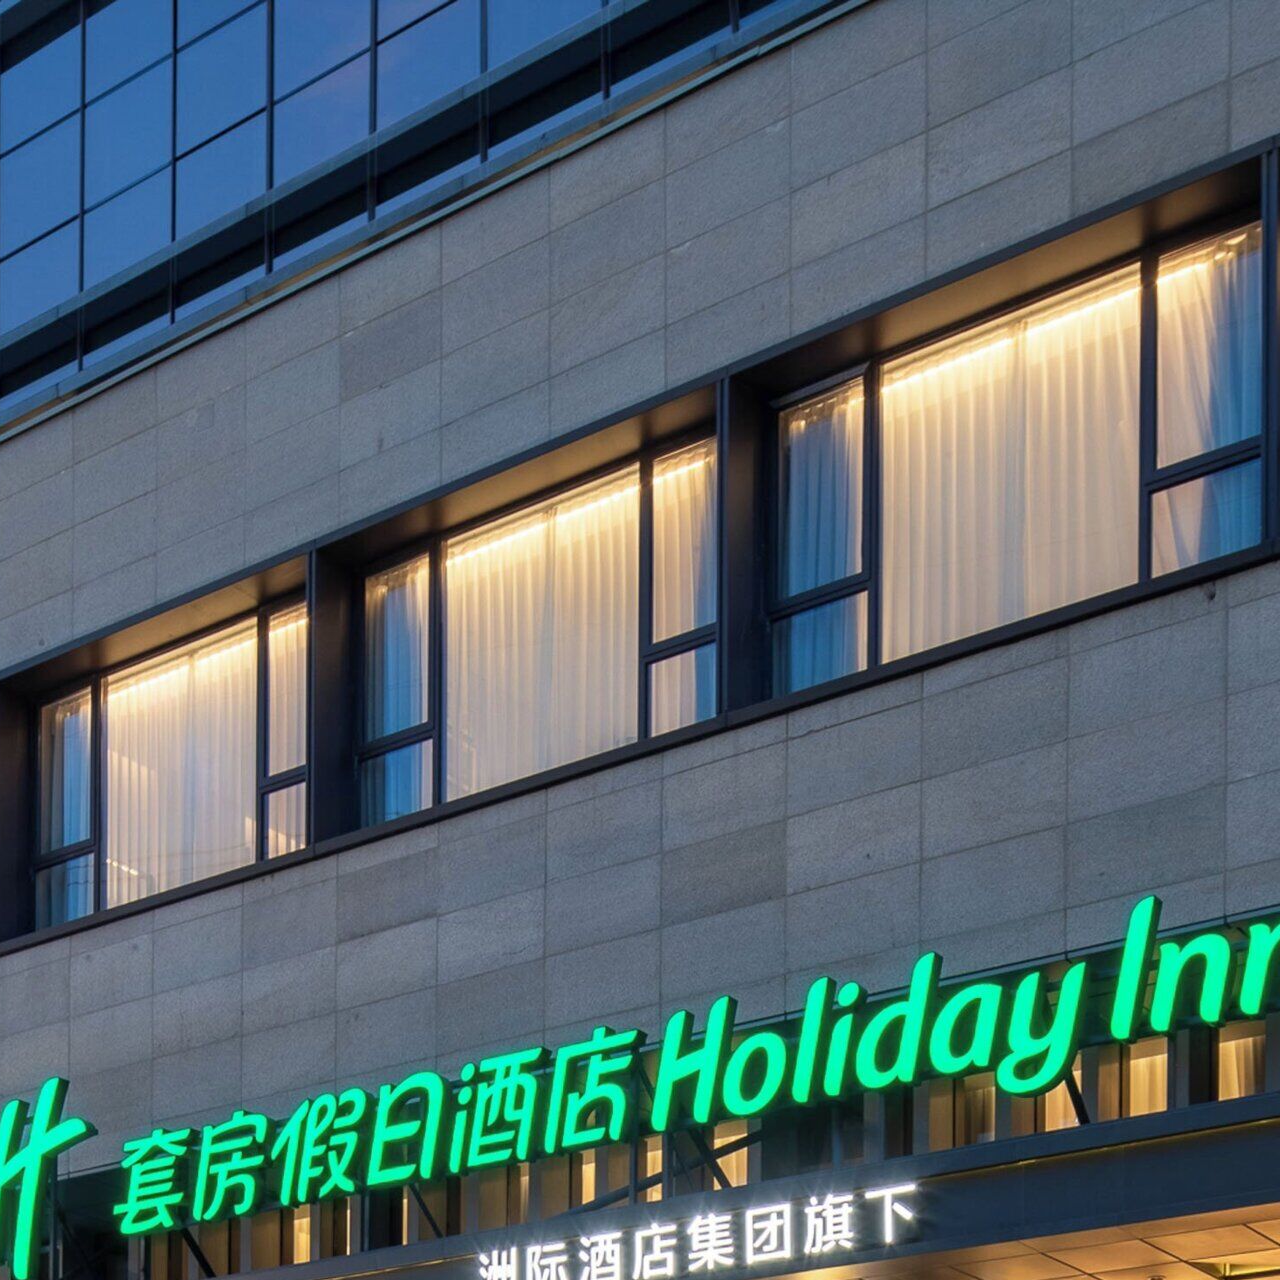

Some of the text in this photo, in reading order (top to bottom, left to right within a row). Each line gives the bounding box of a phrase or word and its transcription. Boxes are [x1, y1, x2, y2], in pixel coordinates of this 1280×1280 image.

[112, 1026, 639, 1235] 套房假日酒店
[650, 951, 1086, 1133] Holiday
